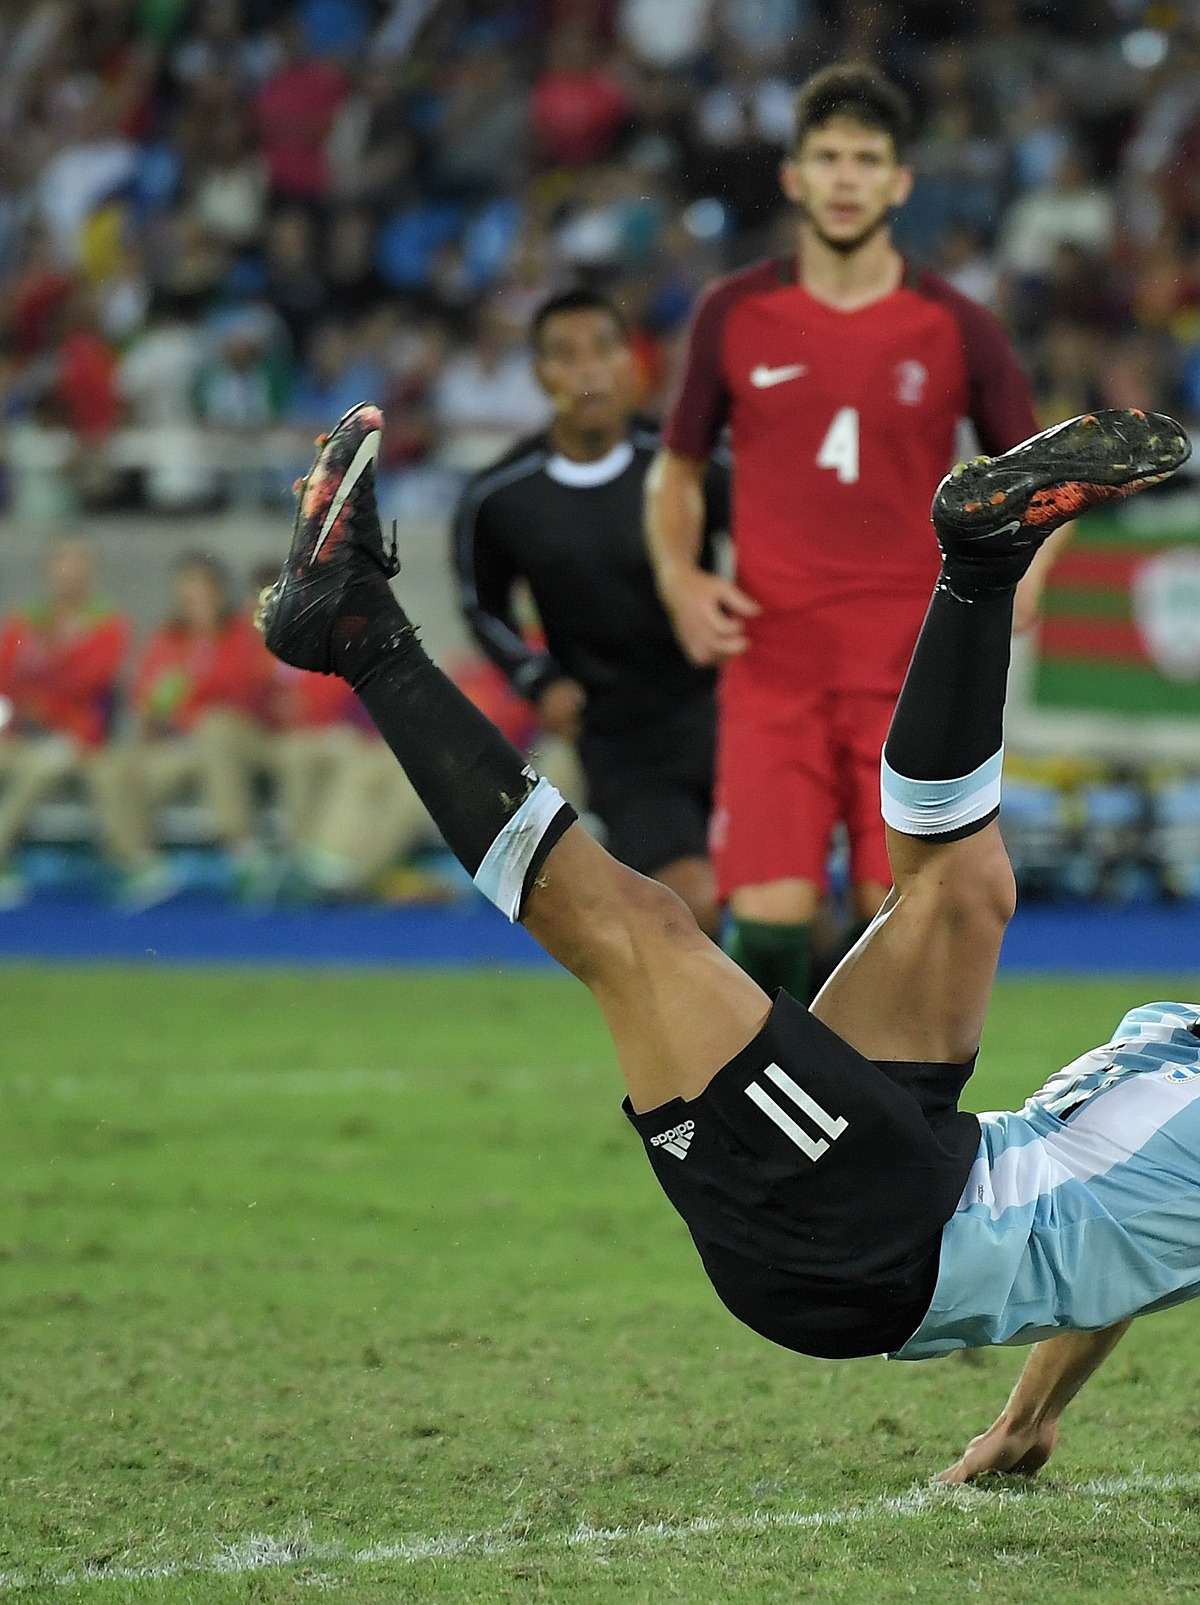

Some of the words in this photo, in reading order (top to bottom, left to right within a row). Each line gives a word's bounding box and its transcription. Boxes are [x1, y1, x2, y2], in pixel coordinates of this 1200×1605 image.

[816, 406, 860, 484] 4
[650, 1120, 695, 1146] adidas
[744, 1062, 849, 1162] 11
